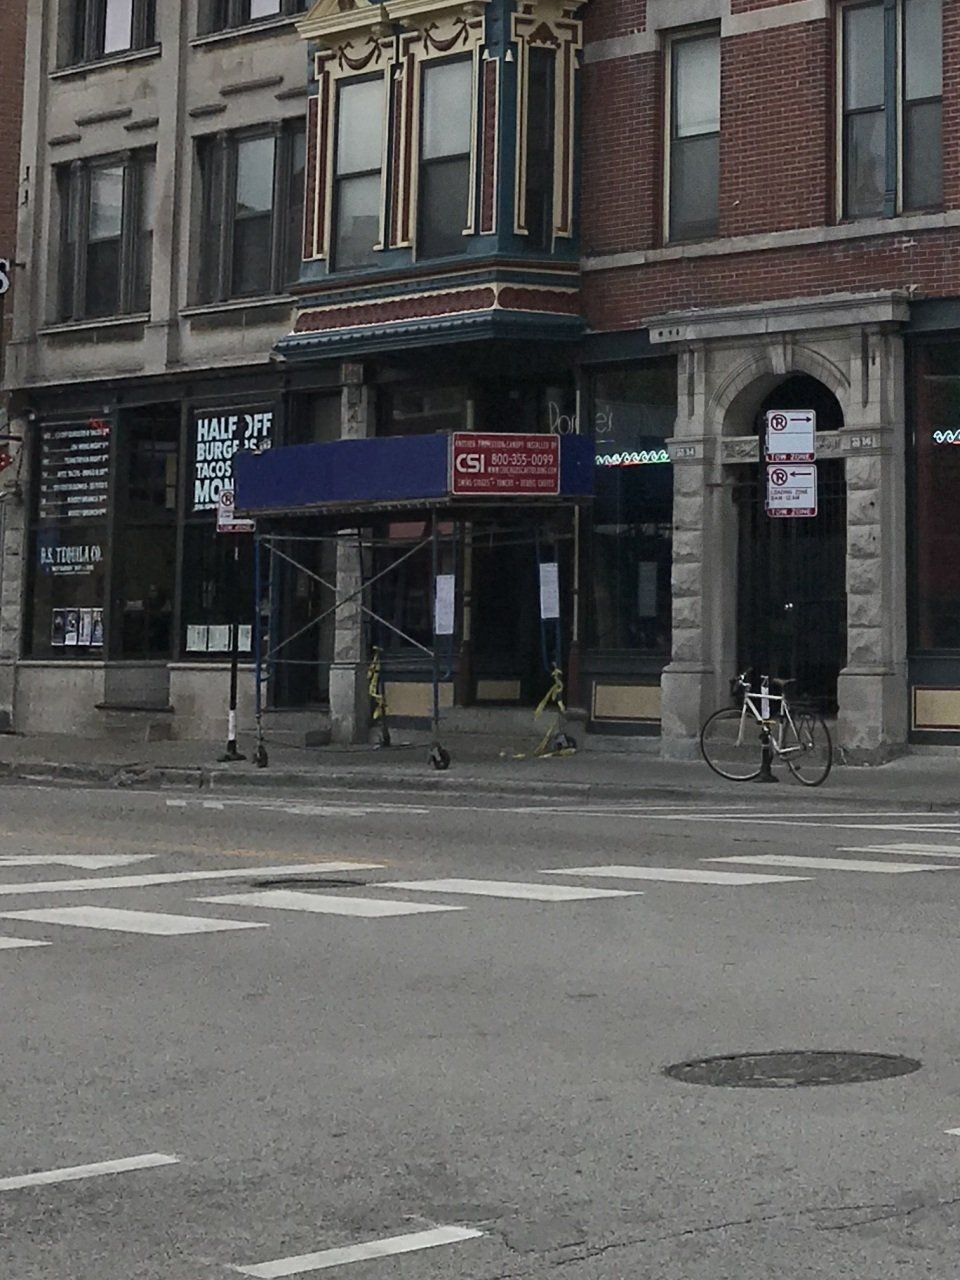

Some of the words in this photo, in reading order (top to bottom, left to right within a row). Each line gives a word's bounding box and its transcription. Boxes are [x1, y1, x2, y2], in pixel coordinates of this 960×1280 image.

[197, 416, 238, 441] HALF
[195, 460, 232, 479] TACOS
[455, 453, 485, 473] CSI
[491, 453, 554, 466] 800-355-0099
